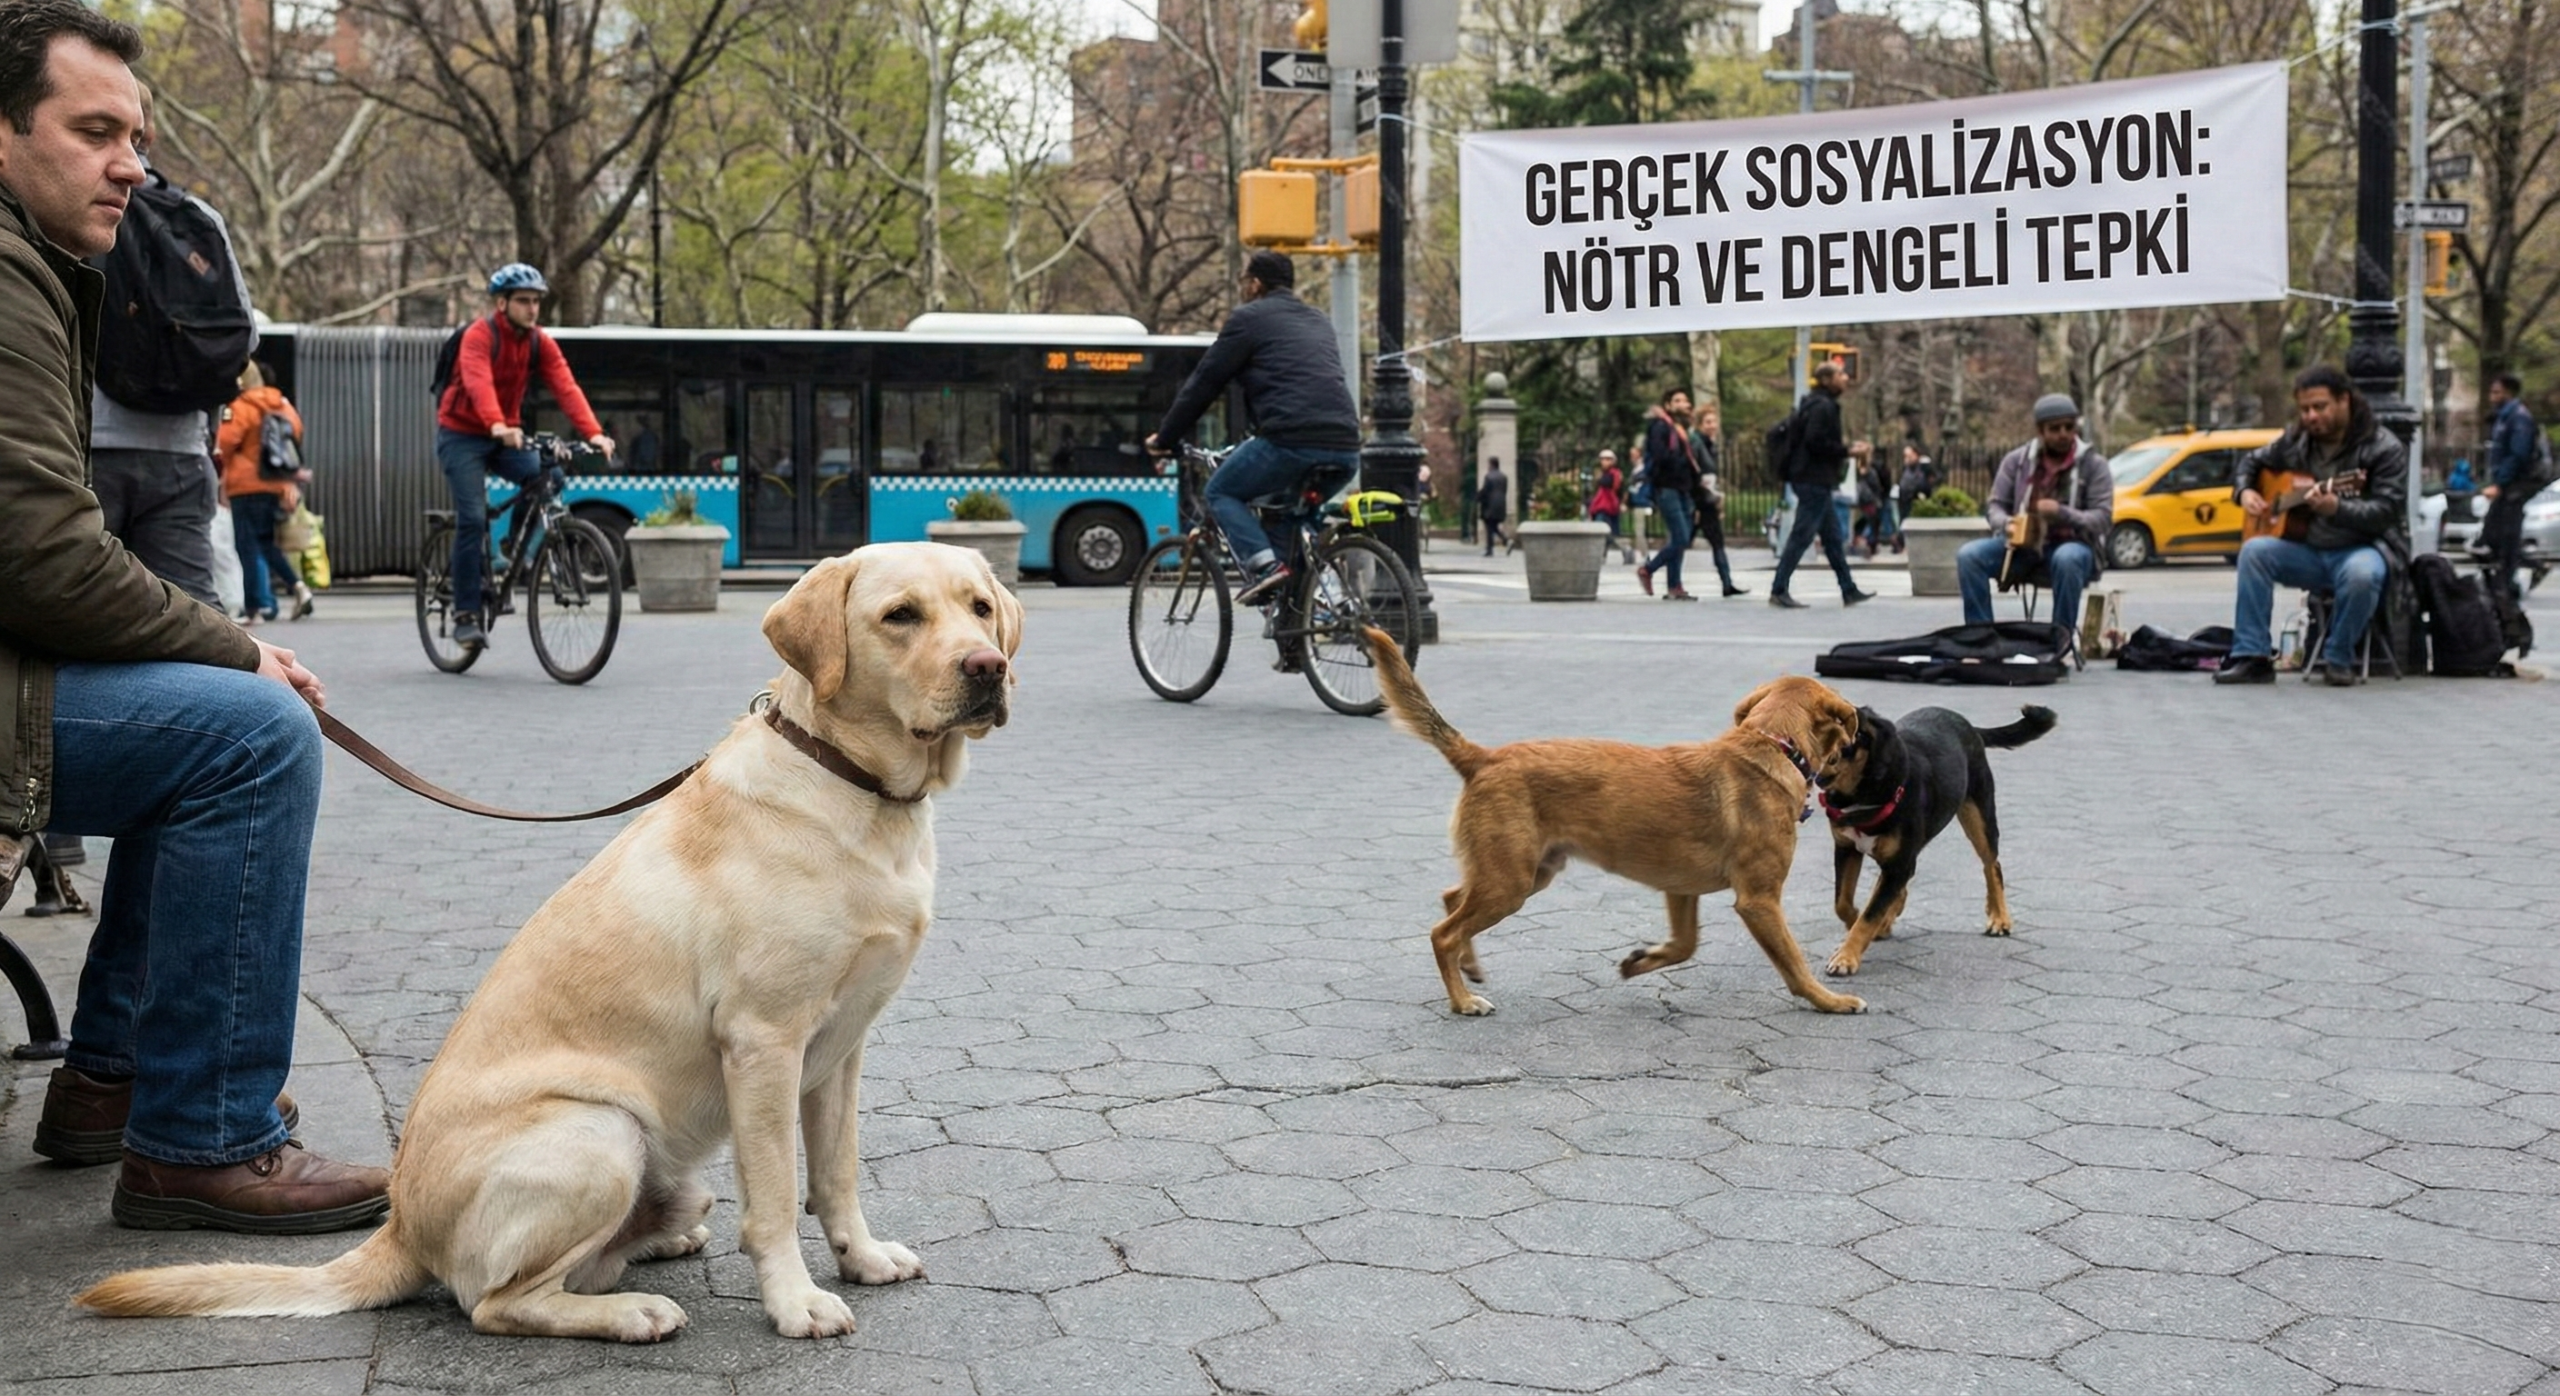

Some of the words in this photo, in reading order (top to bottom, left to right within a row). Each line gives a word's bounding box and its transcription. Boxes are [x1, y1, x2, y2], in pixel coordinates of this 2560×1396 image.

[1525, 149, 1730, 231] GERÇEK
[1746, 109, 2211, 210] SOSYALİZASYON:
[1544, 236, 1681, 314] NÖTR
[1695, 237, 1764, 304] VE
[1781, 207, 2009, 300] DENGELİ
[2025, 192, 2189, 283] TEPKİ
